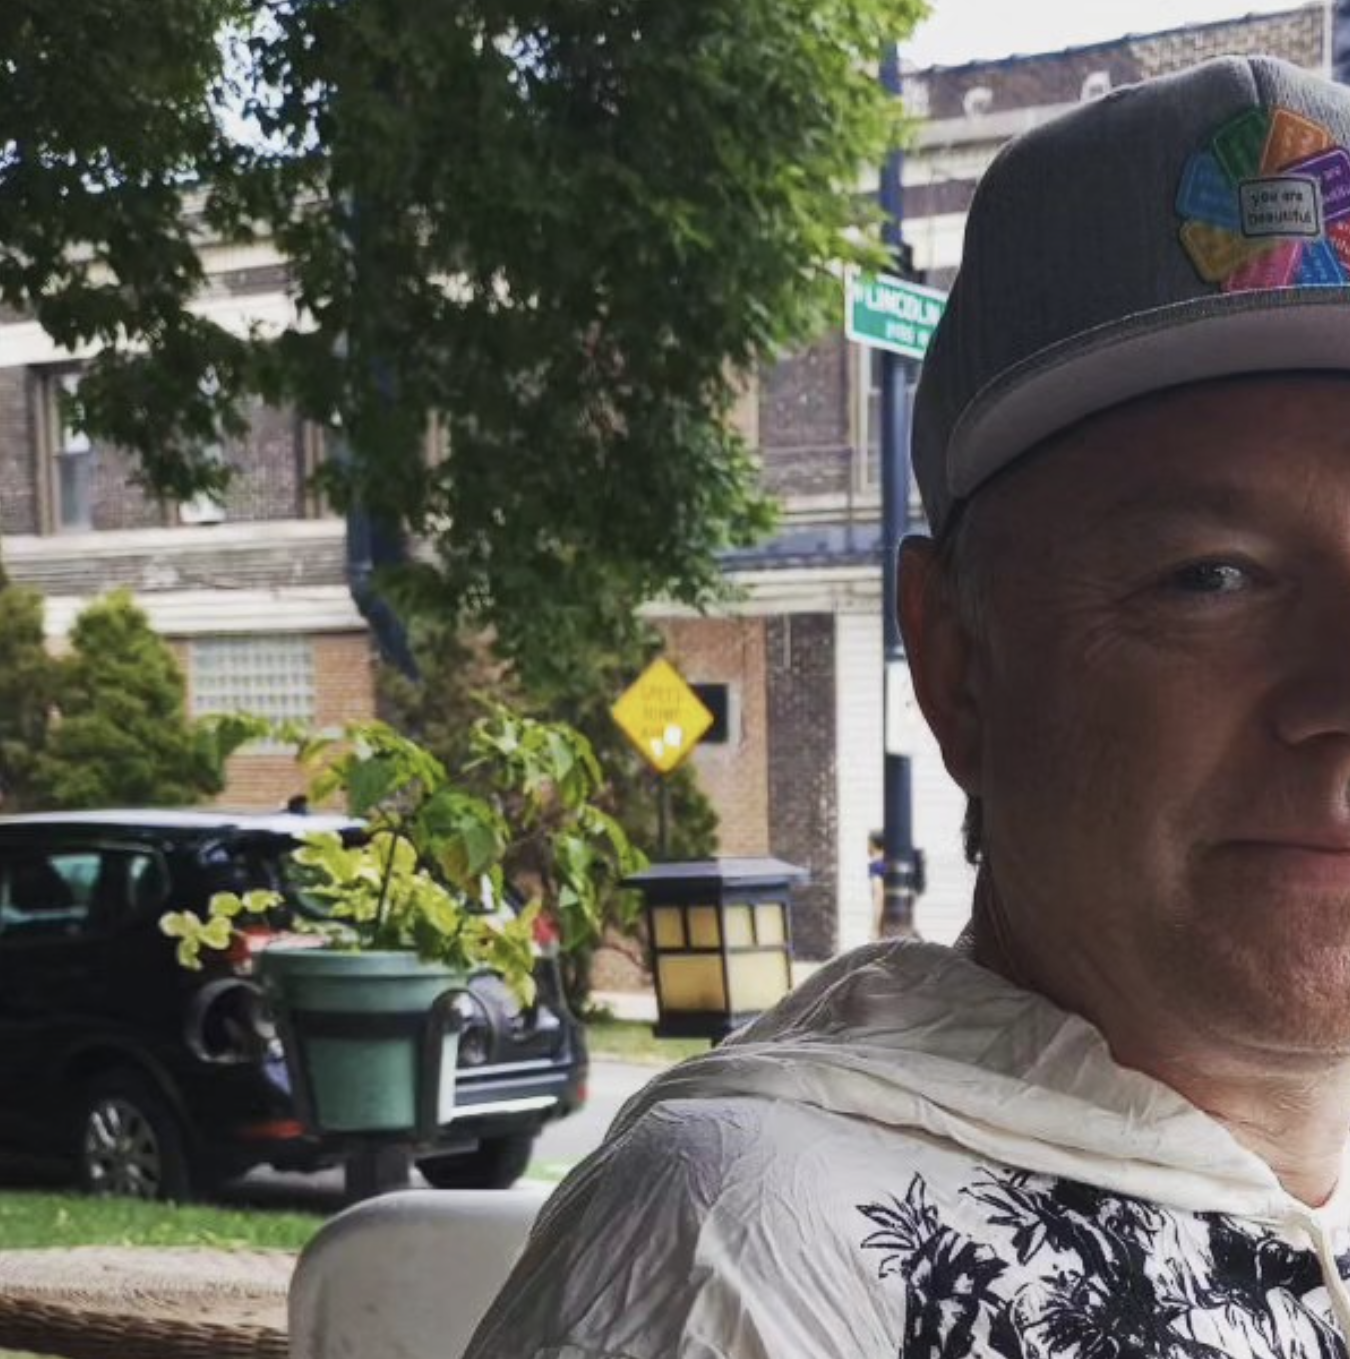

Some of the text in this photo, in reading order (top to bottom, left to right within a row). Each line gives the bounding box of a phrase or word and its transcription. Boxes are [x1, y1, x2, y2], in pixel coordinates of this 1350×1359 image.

[1250, 191, 1278, 208] you
[1281, 191, 1303, 203] are
[1248, 209, 1313, 227] beautiful
